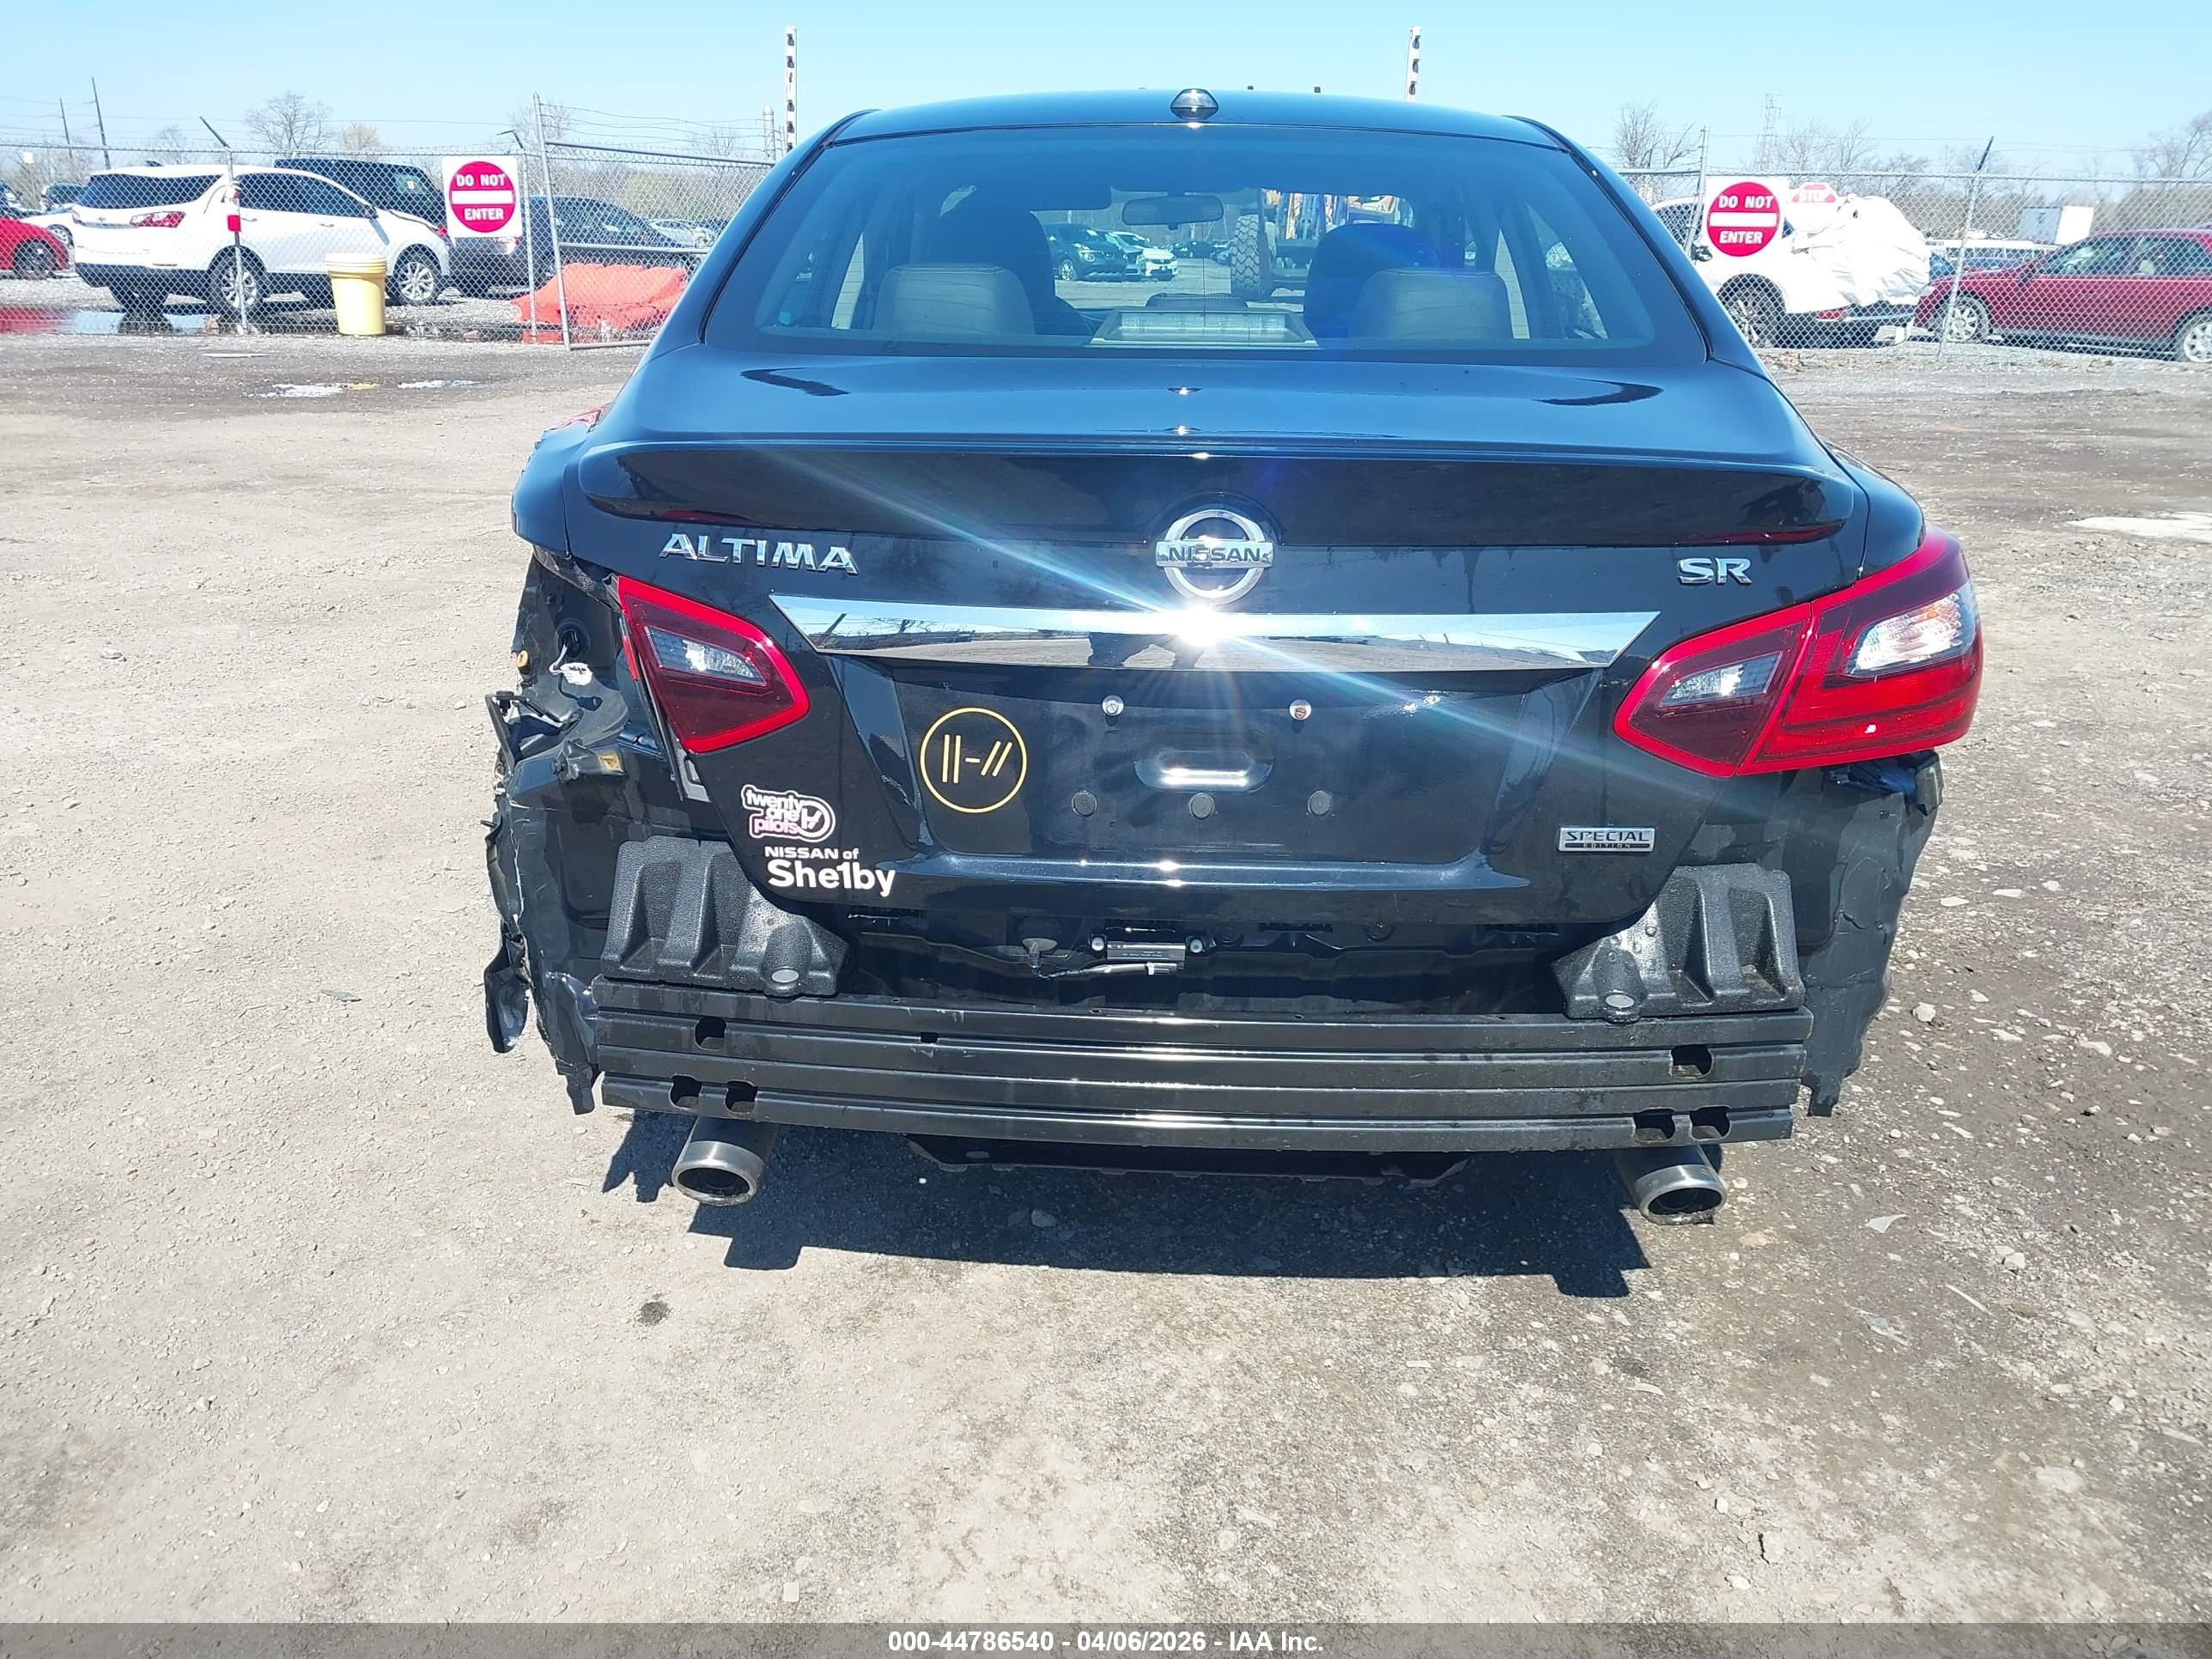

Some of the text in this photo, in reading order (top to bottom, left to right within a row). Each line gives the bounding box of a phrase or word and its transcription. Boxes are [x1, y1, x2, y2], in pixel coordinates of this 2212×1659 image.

[456, 173, 507, 187] DO NOT
[1718, 195, 1774, 209] DO NOT
[464, 207, 504, 221] ENTER
[1719, 230, 1763, 245] ENTER
[659, 532, 860, 574] ALTIMA
[1168, 546, 1261, 562] NISSAN
[1676, 557, 1753, 586] SR
[745, 789, 805, 814] twenty
[766, 807, 799, 822] one
[754, 817, 799, 835] pilots
[1565, 831, 1650, 842] SPECIAL
[764, 846, 860, 860] NISSAN of
